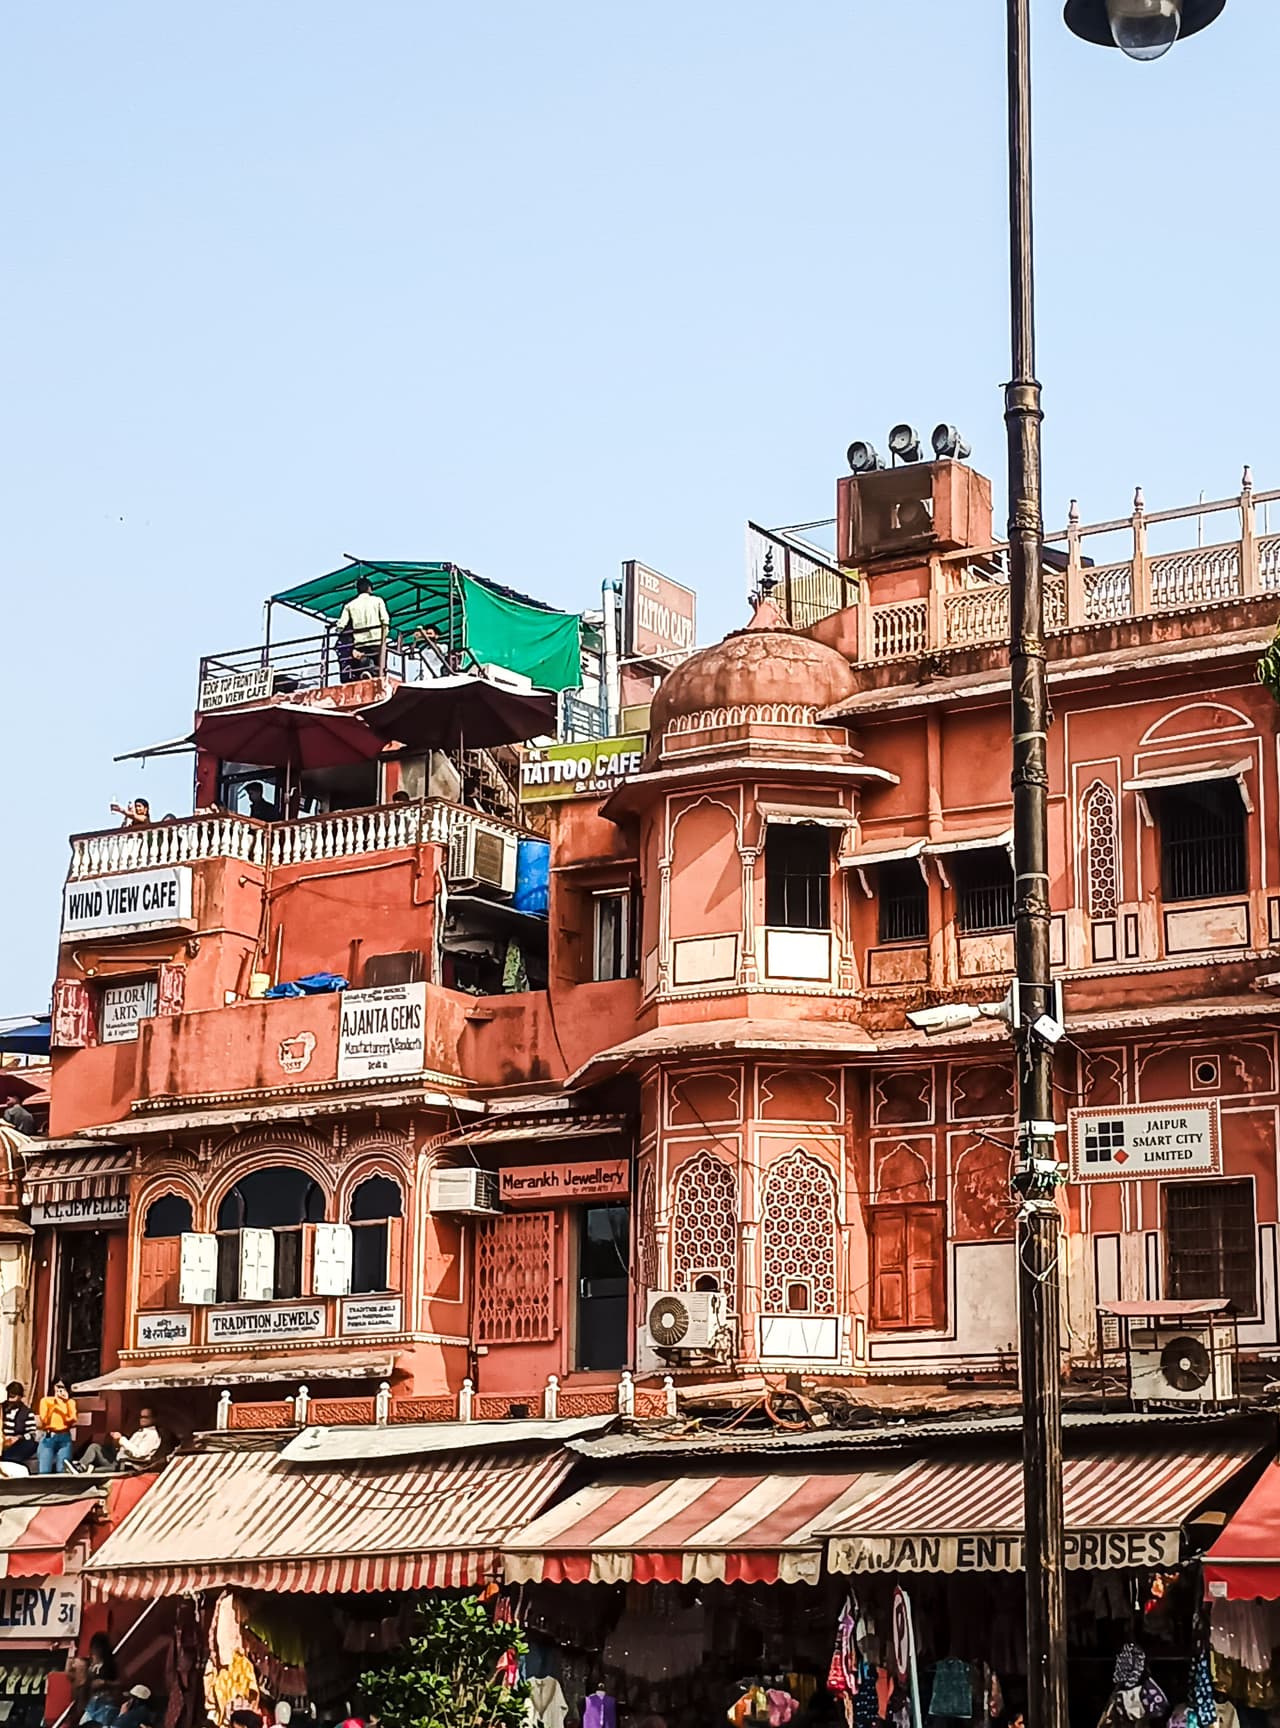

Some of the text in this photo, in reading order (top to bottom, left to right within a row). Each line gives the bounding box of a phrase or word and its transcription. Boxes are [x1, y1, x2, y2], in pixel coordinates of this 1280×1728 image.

[639, 570, 660, 593] THE
[638, 595, 670, 640] TATTOO
[202, 685, 267, 708] WIND VIEW CAFE
[521, 751, 642, 785] TATTOO CAFE
[69, 880, 177, 920] WIND VIEW CAFE
[105, 988, 146, 1006] ELLORA
[112, 1005, 138, 1021] ARTS
[341, 1004, 422, 1038] AJANTA GEMS
[1146, 1118, 1188, 1133] JAIPUR
[1132, 1132, 1204, 1147] SMART CITY
[1144, 1149, 1193, 1162] LIMITED
[502, 1168, 625, 1190] Merankh Jewellery
[213, 1314, 272, 1331] TRADITION
[273, 1310, 320, 1328] JEWELS
[58, 1603, 76, 1623] 31
